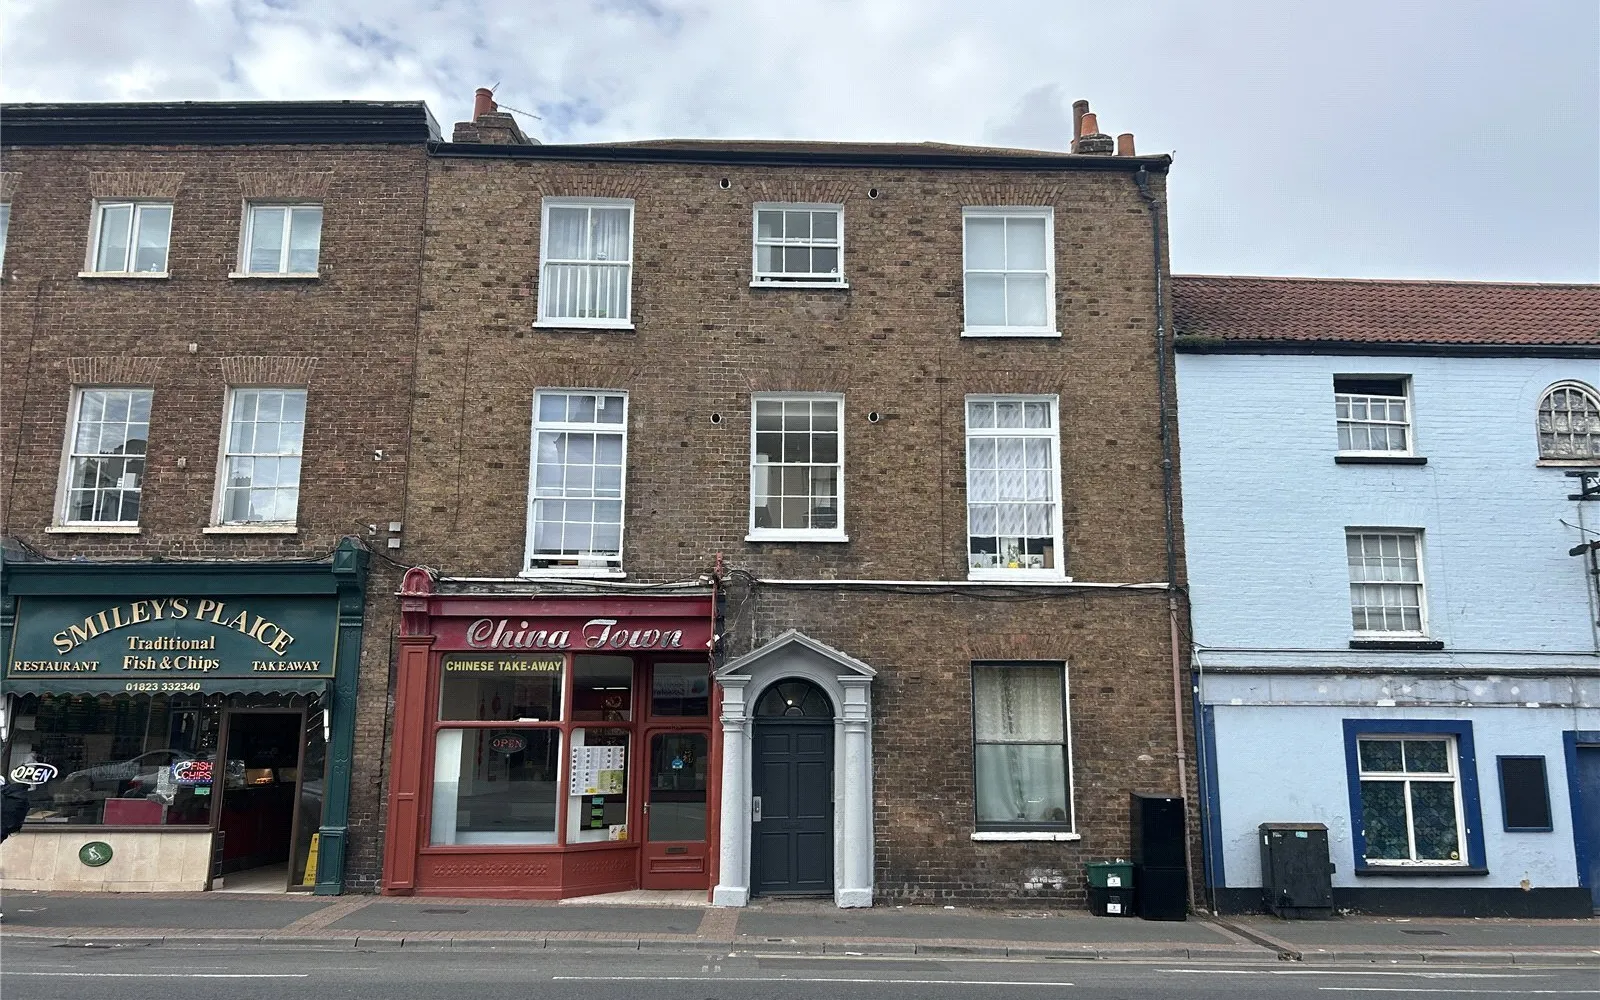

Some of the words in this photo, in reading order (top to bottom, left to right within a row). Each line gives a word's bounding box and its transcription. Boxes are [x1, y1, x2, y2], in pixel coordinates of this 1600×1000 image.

[52, 597, 189, 655] SMILEY'S
[196, 598, 295, 656] PLAICE
[465, 618, 571, 649] China
[582, 618, 683, 649] Town
[127, 635, 215, 650] Traditional
[14, 661, 99, 672] RESTAURANT
[123, 656, 156, 670] Fish
[160, 657, 172, 670] &
[174, 655, 220, 672] Chips
[252, 660, 320, 672] TAKEAWAY
[446, 660, 494, 672] CHINESE
[498, 660, 561, 673] TAKE-AWAY
[126, 683, 158, 691] 01823
[161, 683, 200, 691] 332340
[492, 738, 522, 748] OPEN
[190, 761, 213, 771] FISH
[14, 765, 52, 782] OPEN
[181, 771, 212, 780] CHIPS
